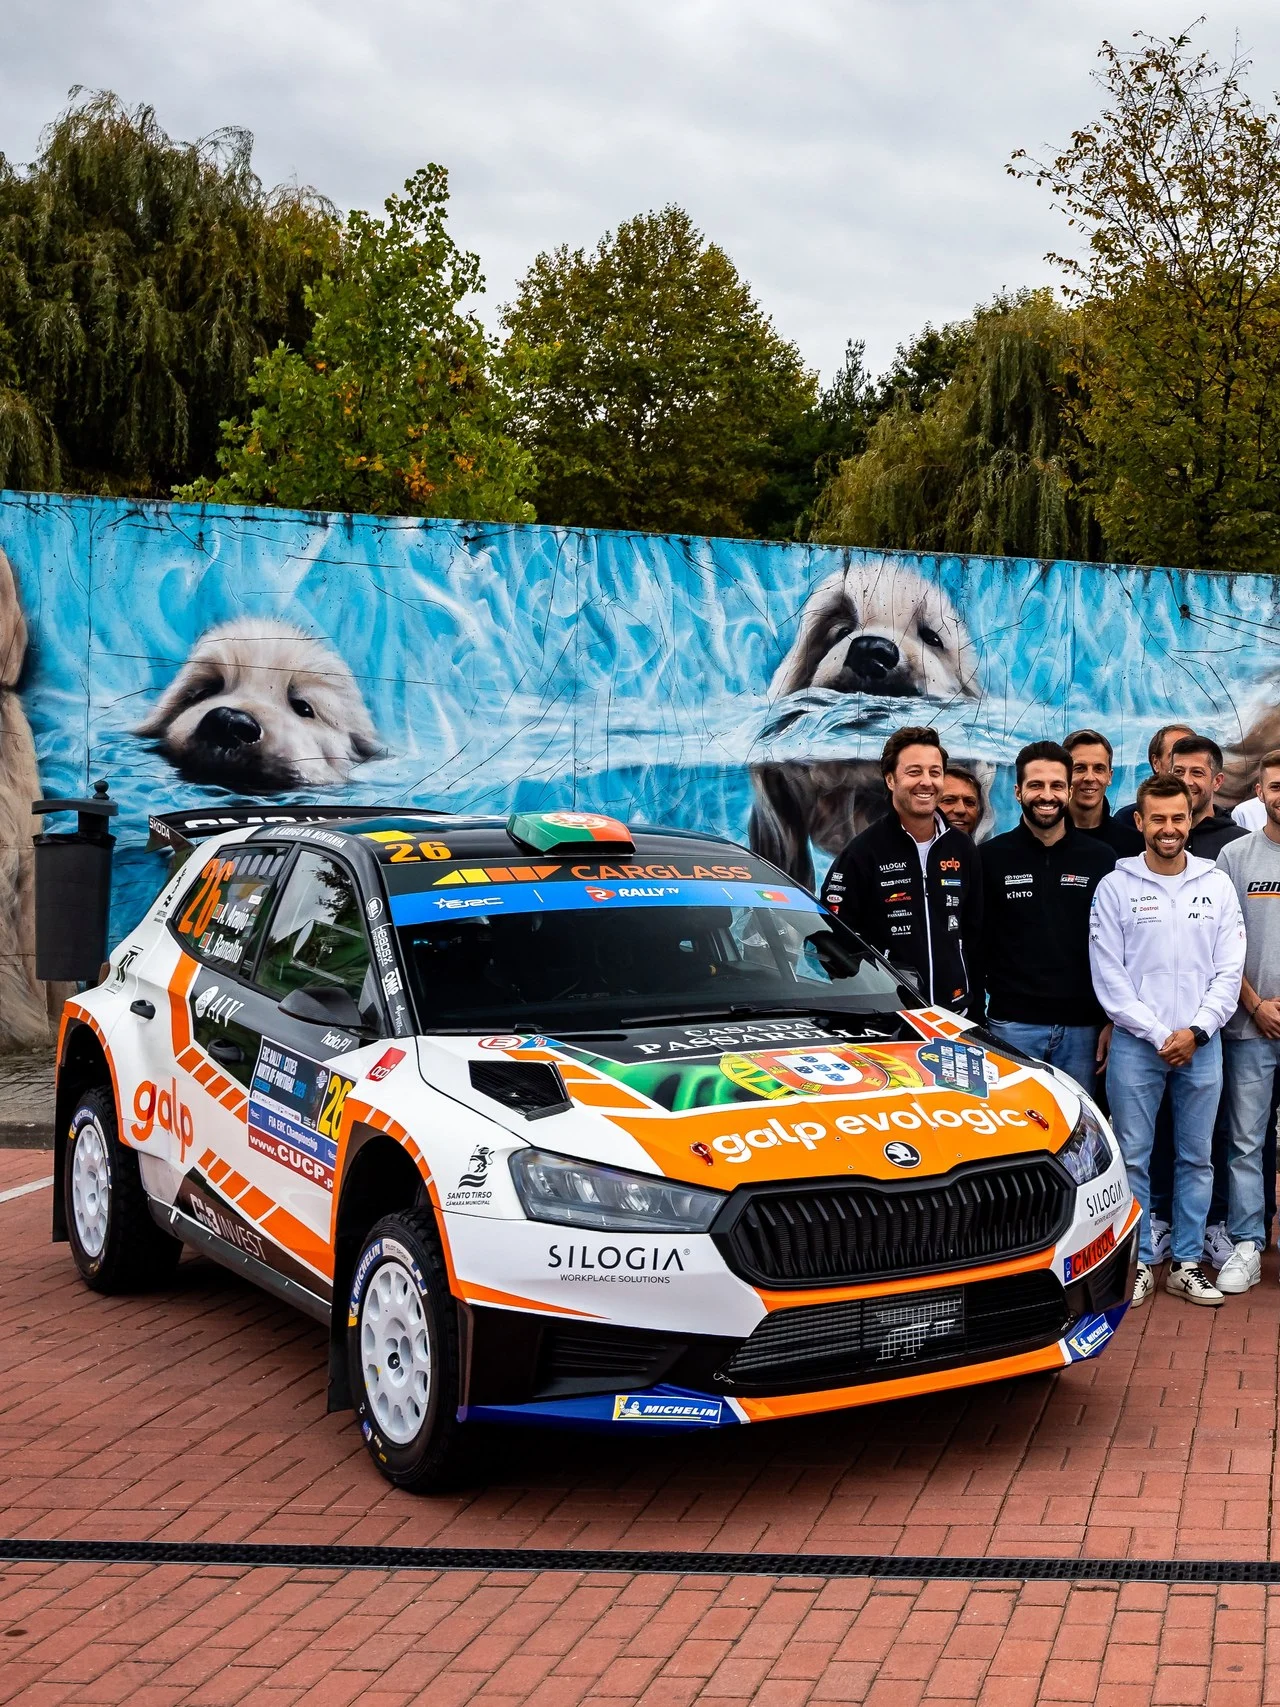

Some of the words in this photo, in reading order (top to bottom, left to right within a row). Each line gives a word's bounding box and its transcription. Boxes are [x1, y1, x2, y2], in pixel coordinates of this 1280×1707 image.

[301, 829, 313, 840] DA
[311, 830, 348, 849] MONTANHA
[385, 842, 451, 862] 26
[880, 862, 907, 872] SILOGIA
[940, 858, 960, 871] galp
[178, 858, 236, 938] 26
[618, 887, 664, 897] RALLY
[212, 934, 243, 964] Ramalho
[384, 970, 399, 996] OMP
[634, 1028, 893, 1055] PASSARELLA
[684, 1023, 764, 1038] CASA
[765, 1022, 819, 1032] DA
[318, 1074, 353, 1140] 26
[131, 1077, 194, 1163] galp
[712, 1117, 827, 1163] galp
[835, 1101, 1028, 1136] evologic
[286, 1123, 318, 1152] Championship
[249, 1134, 334, 1190] www.CUCP.p
[447, 1192, 471, 1200] SANTO
[471, 1191, 492, 1199] TIRSO
[353, 1242, 381, 1300] MICHELIN
[560, 1273, 616, 1283] WORKPLACE
[618, 1274, 671, 1284] SOLUTIONS
[1086, 1321, 1109, 1344] MICHELIN
[643, 1404, 719, 1418] MICHELIN
